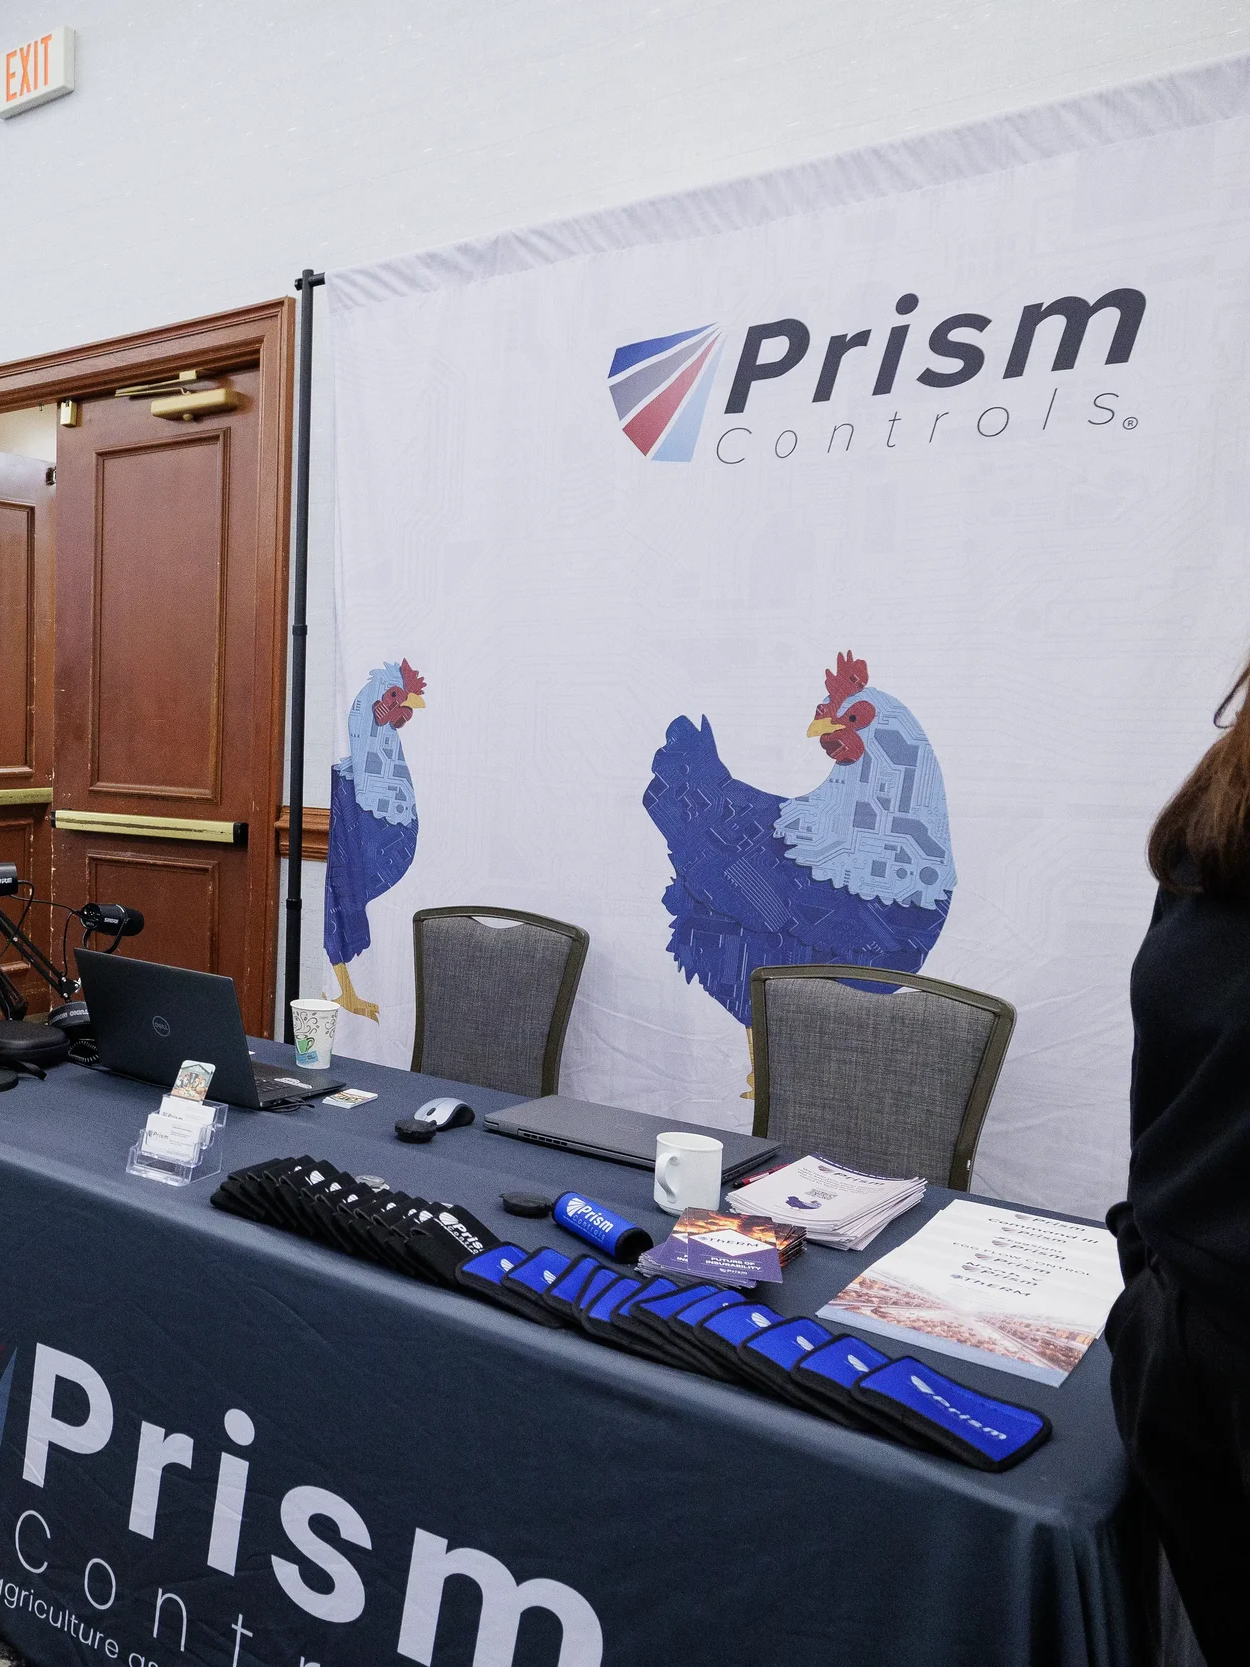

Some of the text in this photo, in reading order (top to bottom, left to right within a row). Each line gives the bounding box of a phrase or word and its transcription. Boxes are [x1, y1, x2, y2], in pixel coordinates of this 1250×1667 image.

[5, 33, 52, 102] EXIT
[723, 287, 1147, 415] Prism
[152, 1131, 169, 1140] Prism
[572, 1214, 606, 1241] Controls
[577, 1205, 614, 1233] Prism
[988, 1218, 1078, 1240] Command
[1032, 1218, 1086, 1232] Prism
[452, 1223, 485, 1252] Pris
[1017, 1230, 1067, 1244] Prism
[711, 1257, 743, 1265] FUTURE
[984, 1249, 1022, 1260] FLOW
[1025, 1259, 1092, 1276] CONTROL
[1010, 1245, 1067, 1260] Prism
[705, 1260, 761, 1270] INSURABILITY
[993, 1258, 1051, 1275] Prism
[980, 1269, 1038, 1286] Prism
[932, 1395, 1008, 1441] Prism
[21, 1342, 604, 1667] Prism
[15, 1509, 321, 1667] Cont
